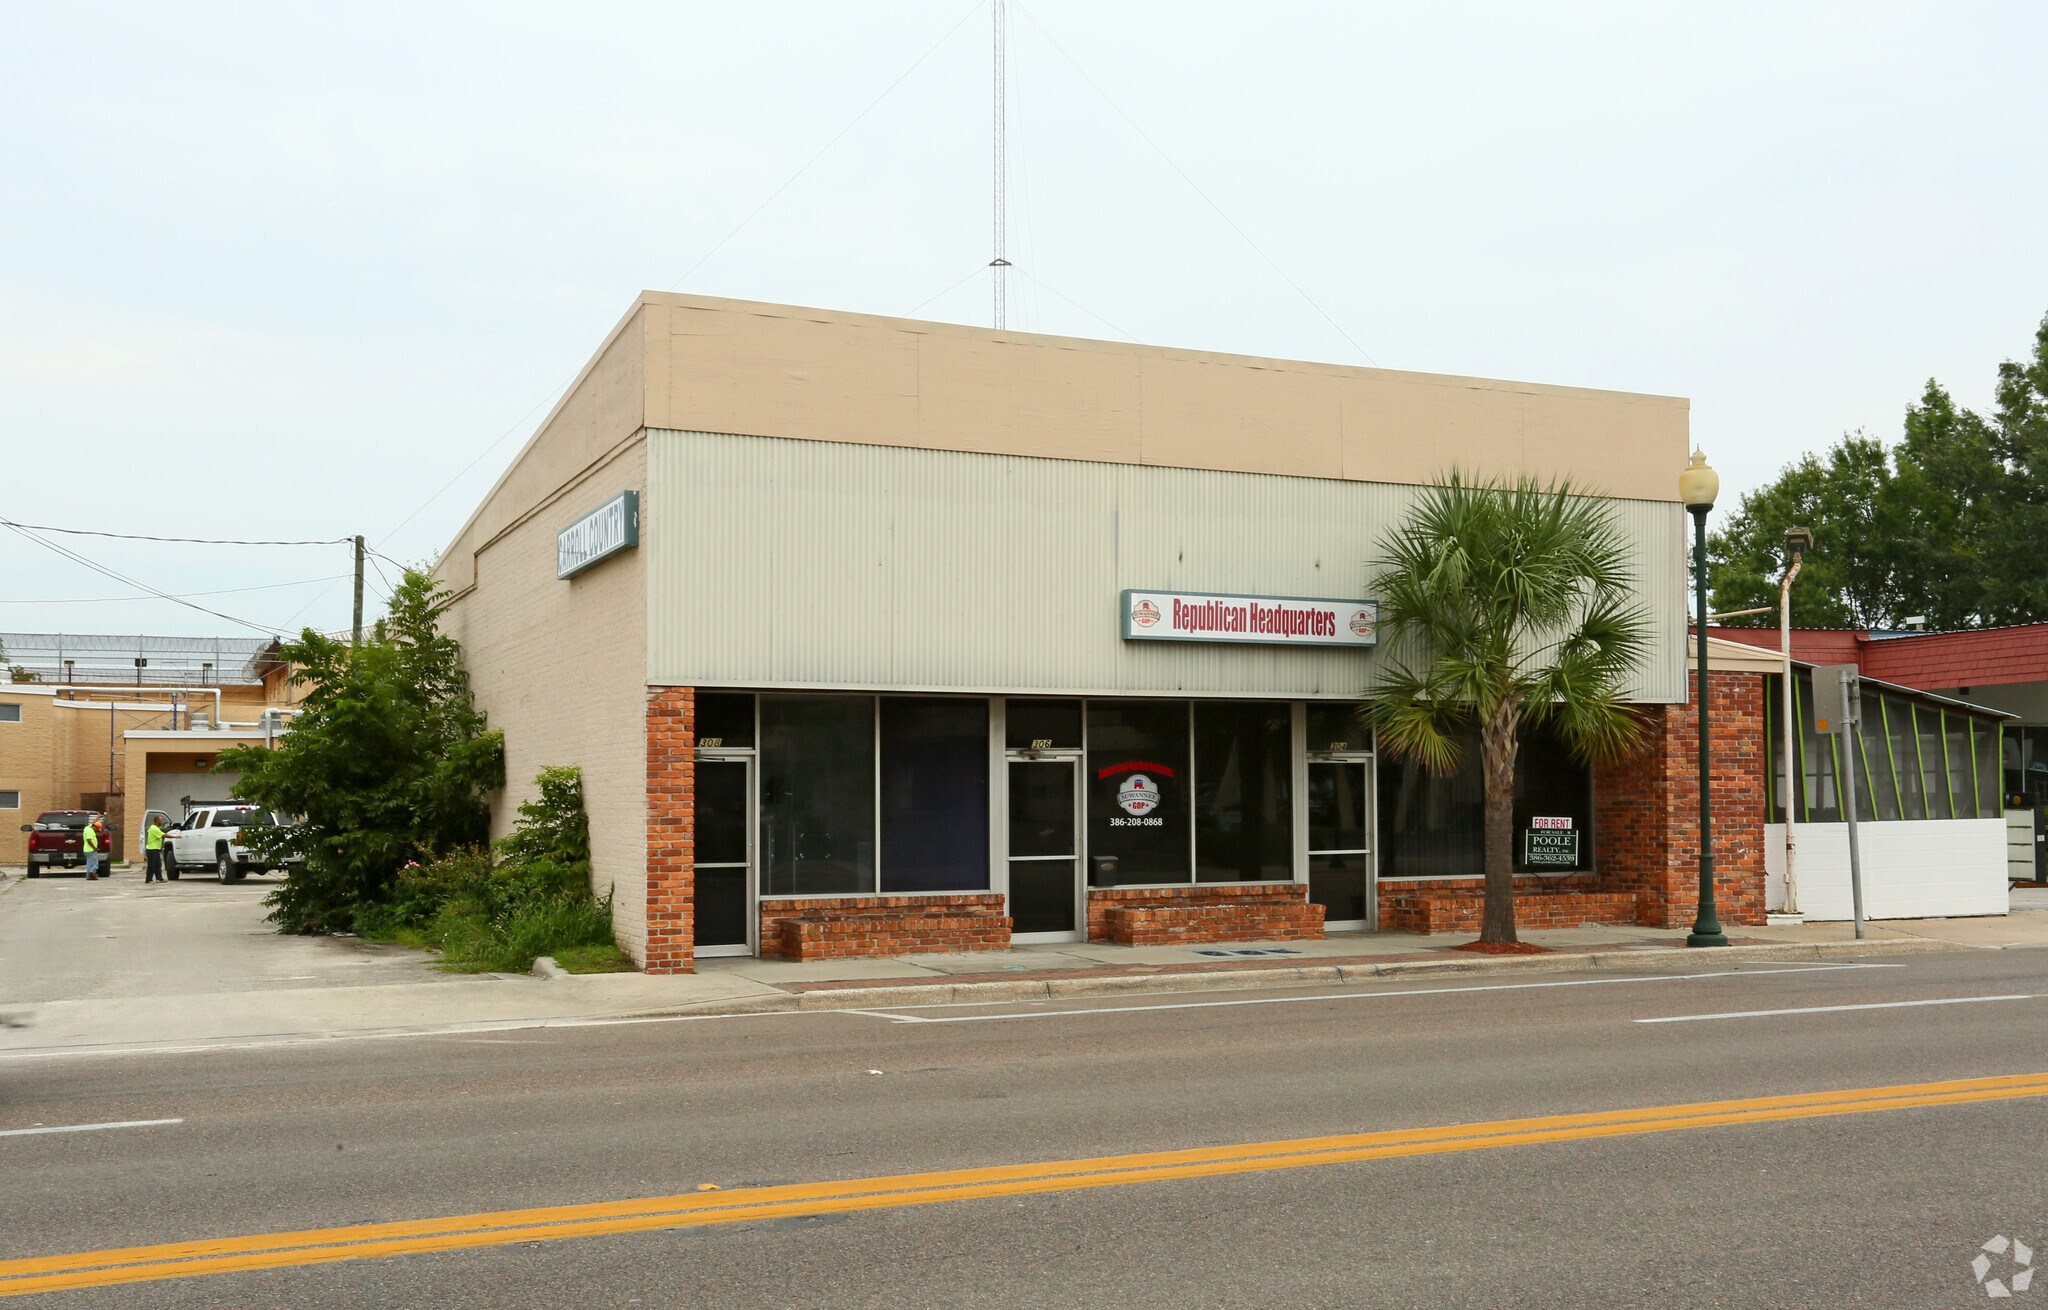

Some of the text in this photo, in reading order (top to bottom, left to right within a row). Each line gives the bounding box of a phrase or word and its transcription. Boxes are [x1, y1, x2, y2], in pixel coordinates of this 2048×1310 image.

[589, 499, 624, 557] COUNTRY
[1173, 598, 1335, 637] Republican Headquarters
[700, 738, 720, 747] 308
[1032, 740, 1050, 748] 306
[1121, 792, 1157, 800] SUWANNEE
[1132, 801, 1146, 809] GOP
[1109, 817, 1163, 826] 386-208-0868
[1534, 818, 1570, 829] FOR RENT
[1533, 836, 1571, 846] POOLE
[1532, 846, 1561, 854] REALTY,
